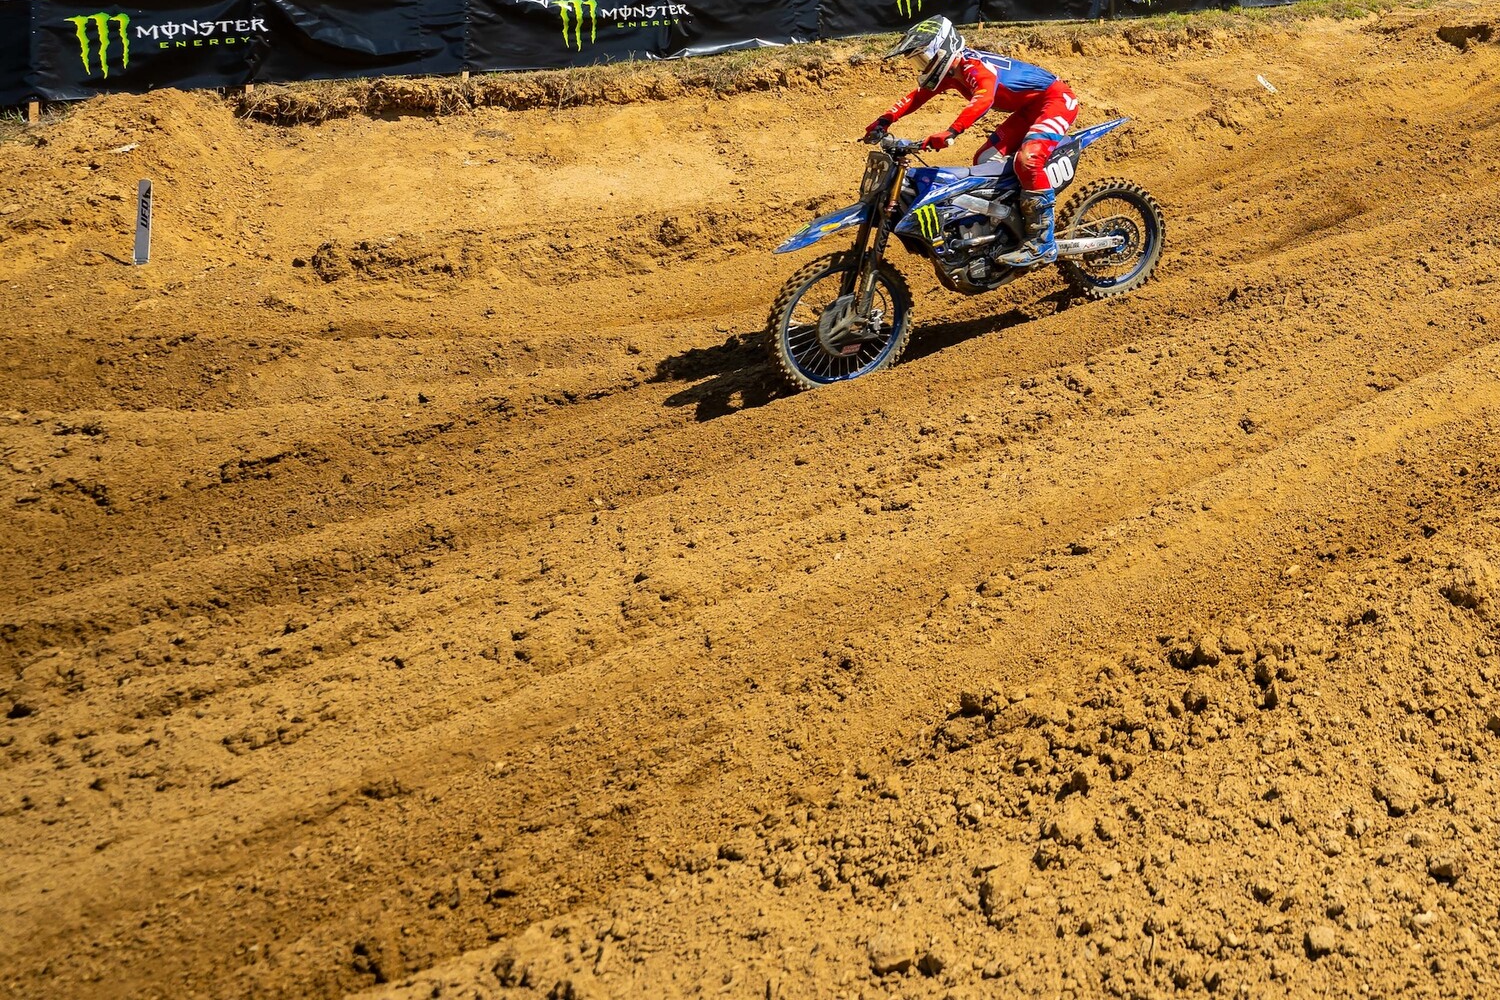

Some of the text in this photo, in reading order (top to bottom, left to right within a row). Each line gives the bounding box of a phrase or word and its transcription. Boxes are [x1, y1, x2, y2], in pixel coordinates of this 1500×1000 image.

[602, 4, 690, 20] MONSTER
[136, 18, 269, 40] MONSTER
[617, 18, 680, 28] ENERGY
[160, 36, 250, 49] ENERGY
[1090, 120, 1121, 135] DUNLOP
[140, 199, 148, 228] UFO
